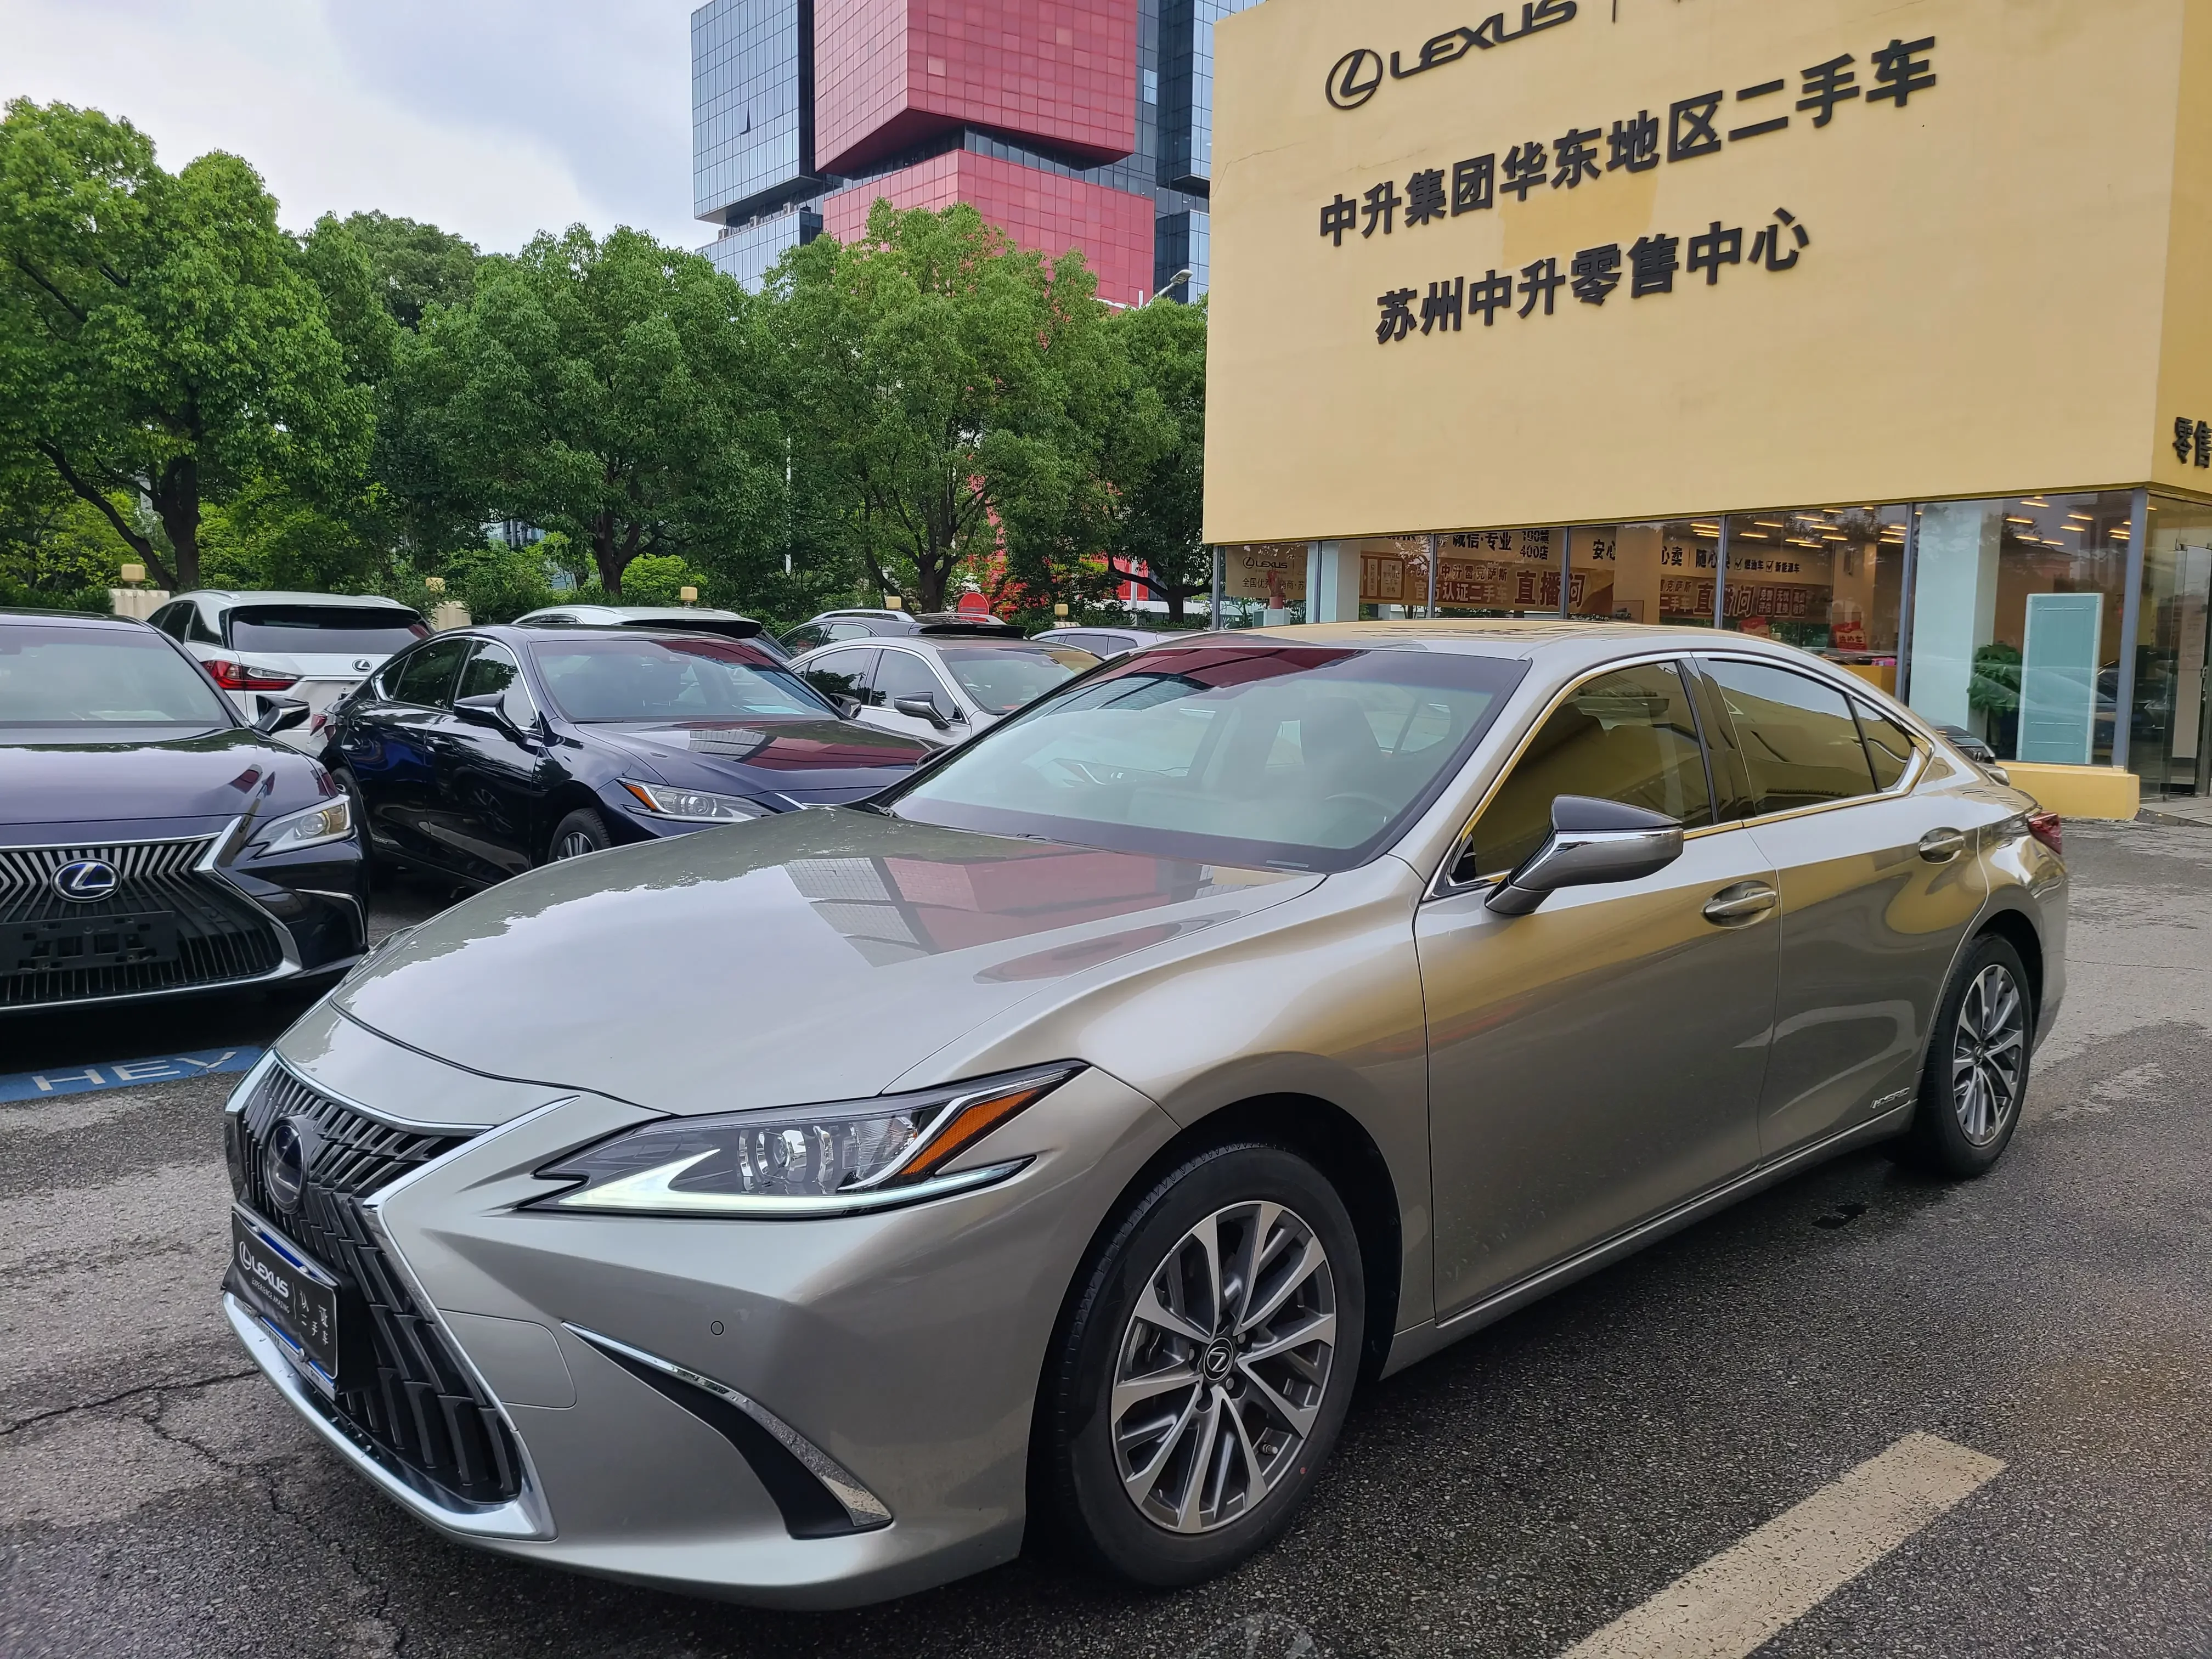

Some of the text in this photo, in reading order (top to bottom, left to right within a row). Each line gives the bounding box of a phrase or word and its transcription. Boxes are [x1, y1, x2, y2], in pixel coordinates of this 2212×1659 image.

[1391, 0, 1577, 79] LEXUS
[1320, 36, 1936, 246] 中升集团华东地区二手车
[1376, 207, 1809, 345] 苏州中升零售中心
[2172, 417, 2212, 468] 零售
[1255, 560, 1288, 568] LEXUS
[252, 1255, 289, 1298] LEXUS
